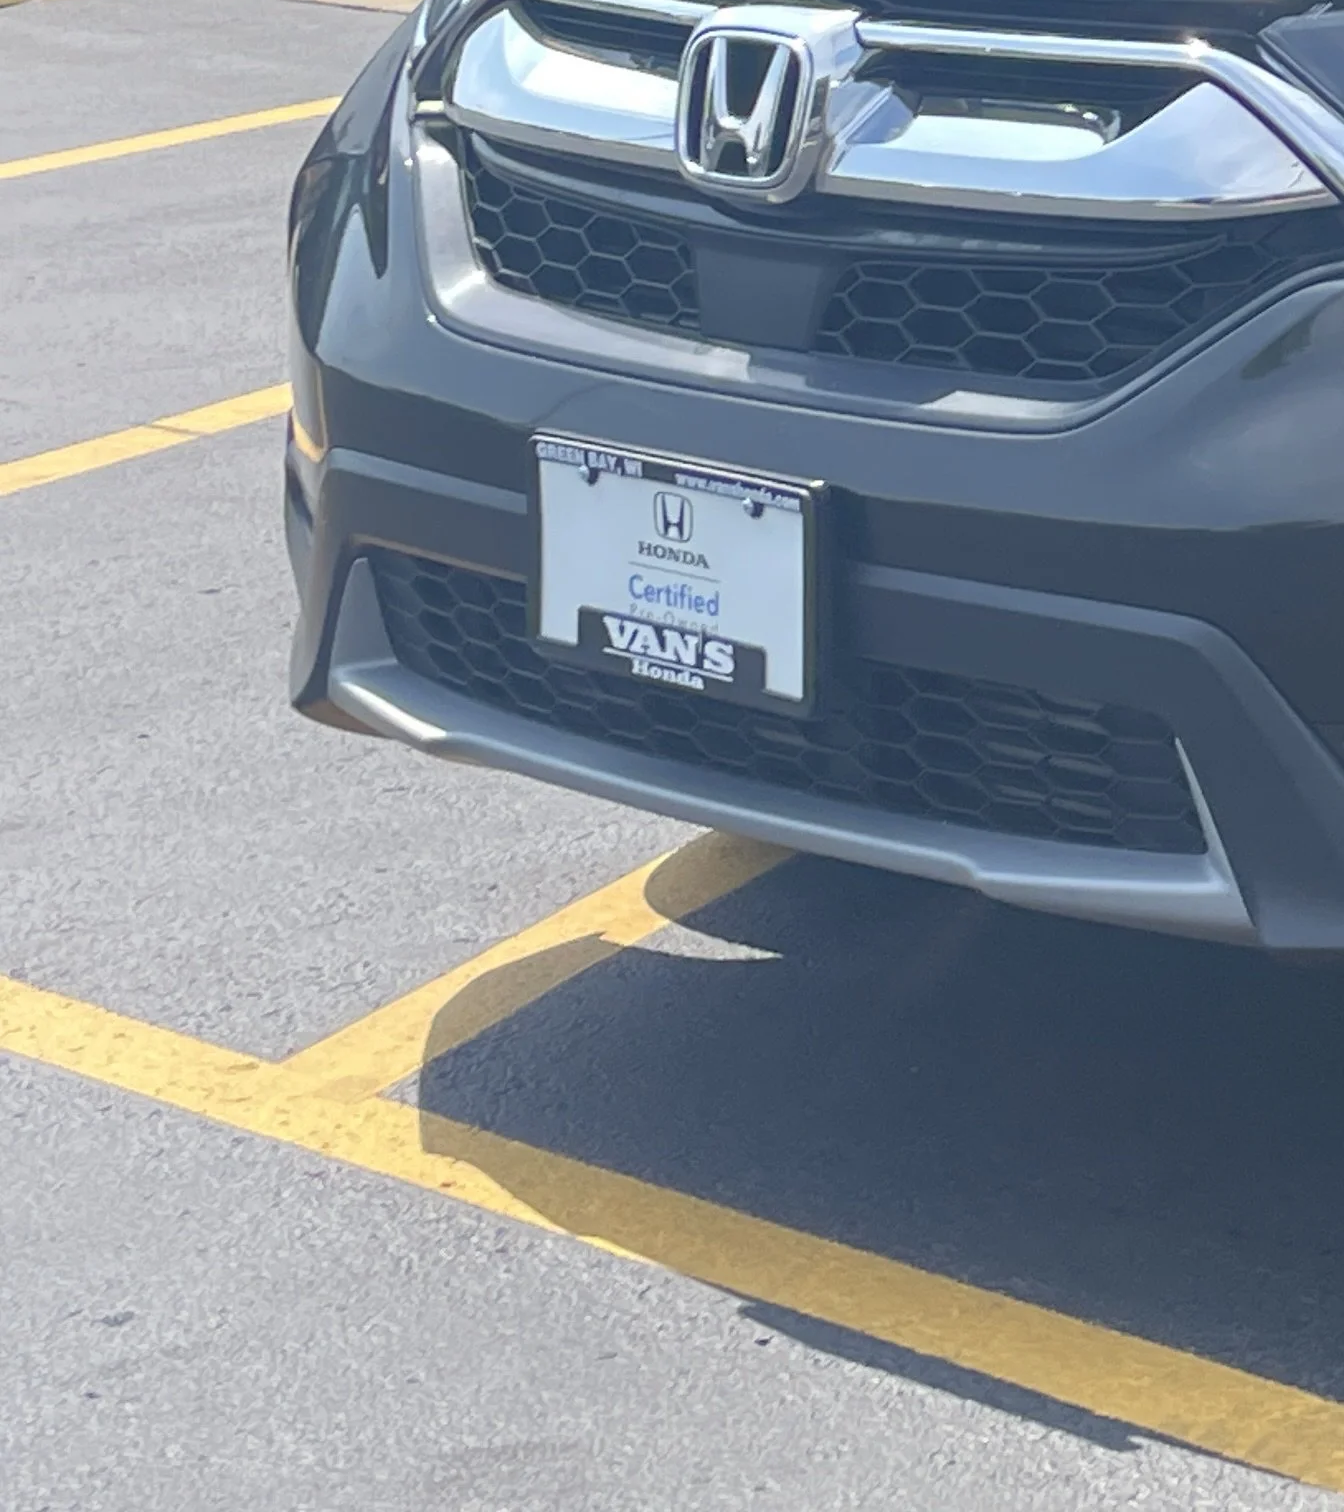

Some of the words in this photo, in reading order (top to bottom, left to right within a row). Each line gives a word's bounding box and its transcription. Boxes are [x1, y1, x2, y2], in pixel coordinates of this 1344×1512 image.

[535, 441, 585, 465] GREEN
[638, 540, 709, 569] HONDA
[628, 573, 719, 617] Certified
[631, 657, 705, 691] Honda
